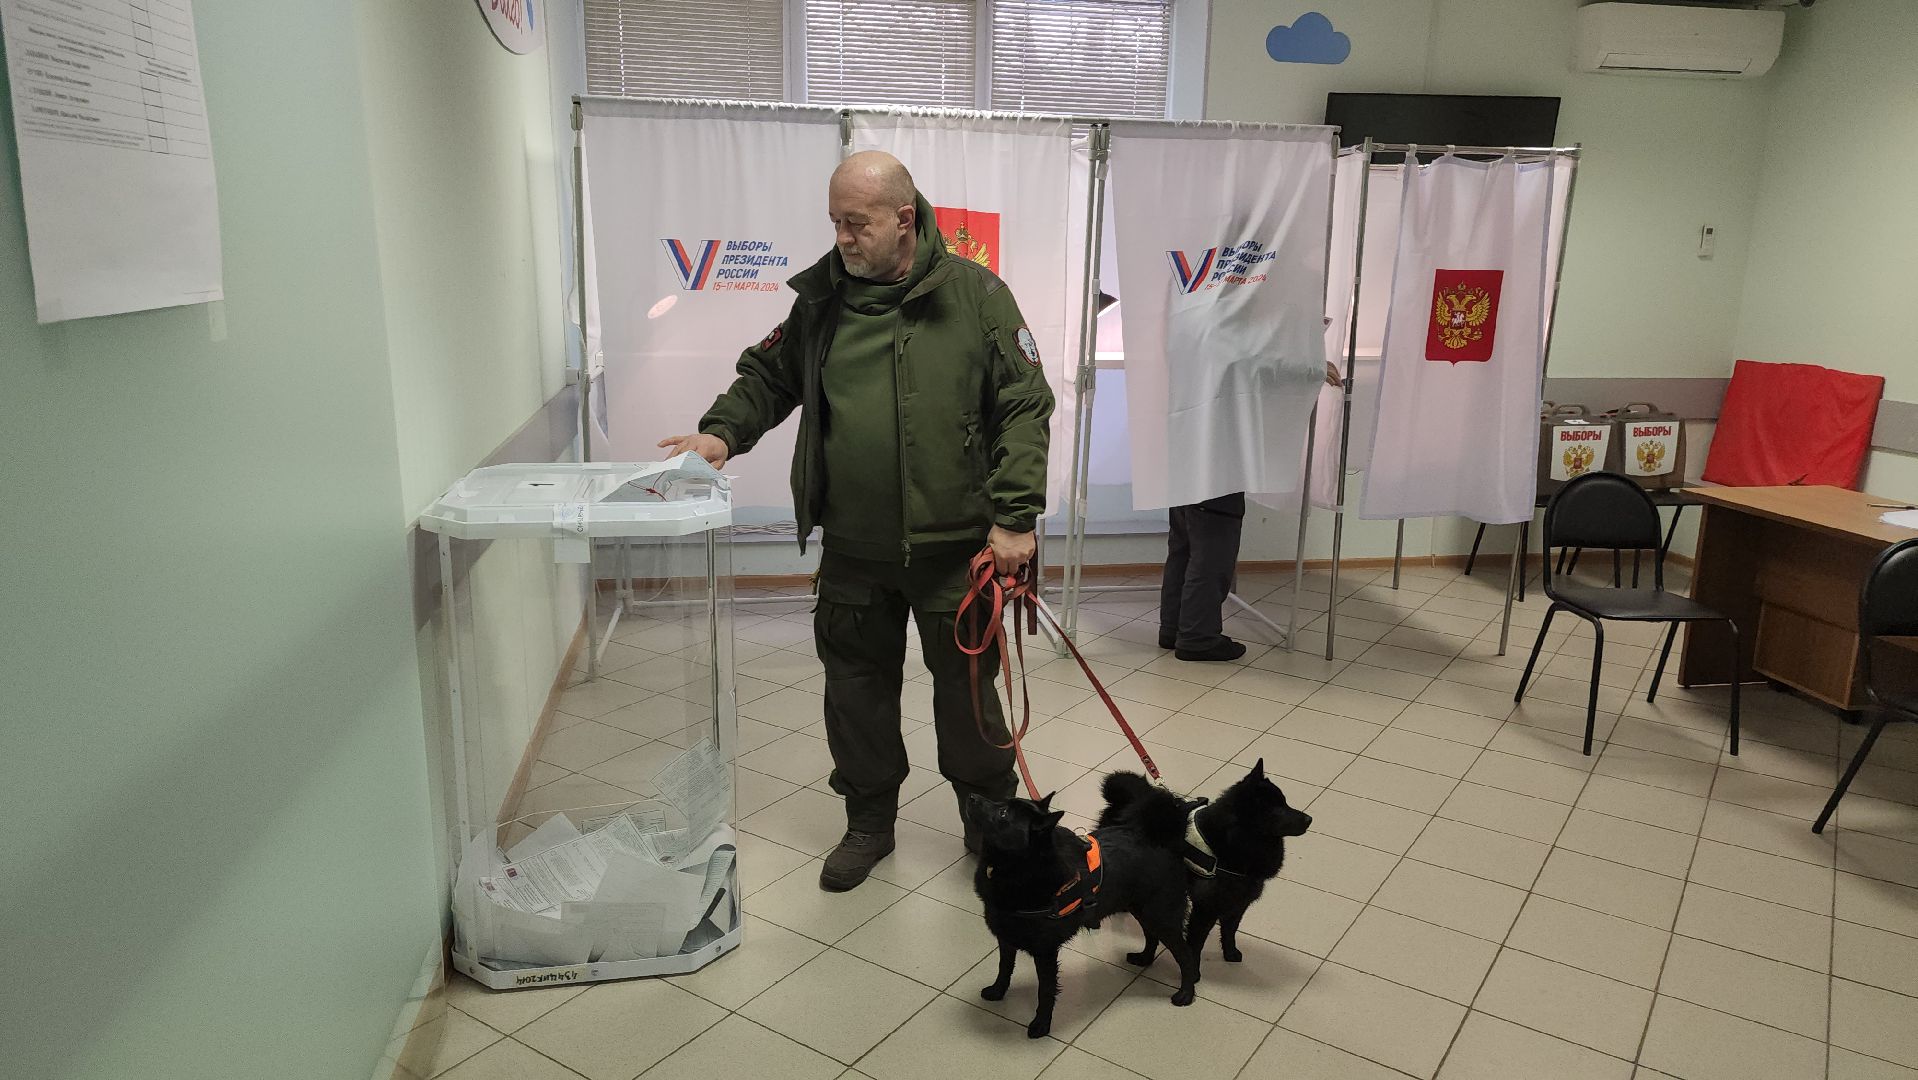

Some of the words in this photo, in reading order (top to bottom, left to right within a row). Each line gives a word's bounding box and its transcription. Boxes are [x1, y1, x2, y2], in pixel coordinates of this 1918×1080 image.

[726, 240, 773, 252] ВЫБОРЫ
[1222, 240, 1264, 257] ВЫОРЫ
[721, 254, 788, 267] ПРЕЗИДЕНТА
[715, 268, 760, 280] РОССИИ
[733, 281, 760, 291] МАРТА
[760, 282, 780, 292] 2024
[1560, 430, 1602, 441] ВЫБОРЫ
[1633, 425, 1672, 437] ВЫБОРЫ
